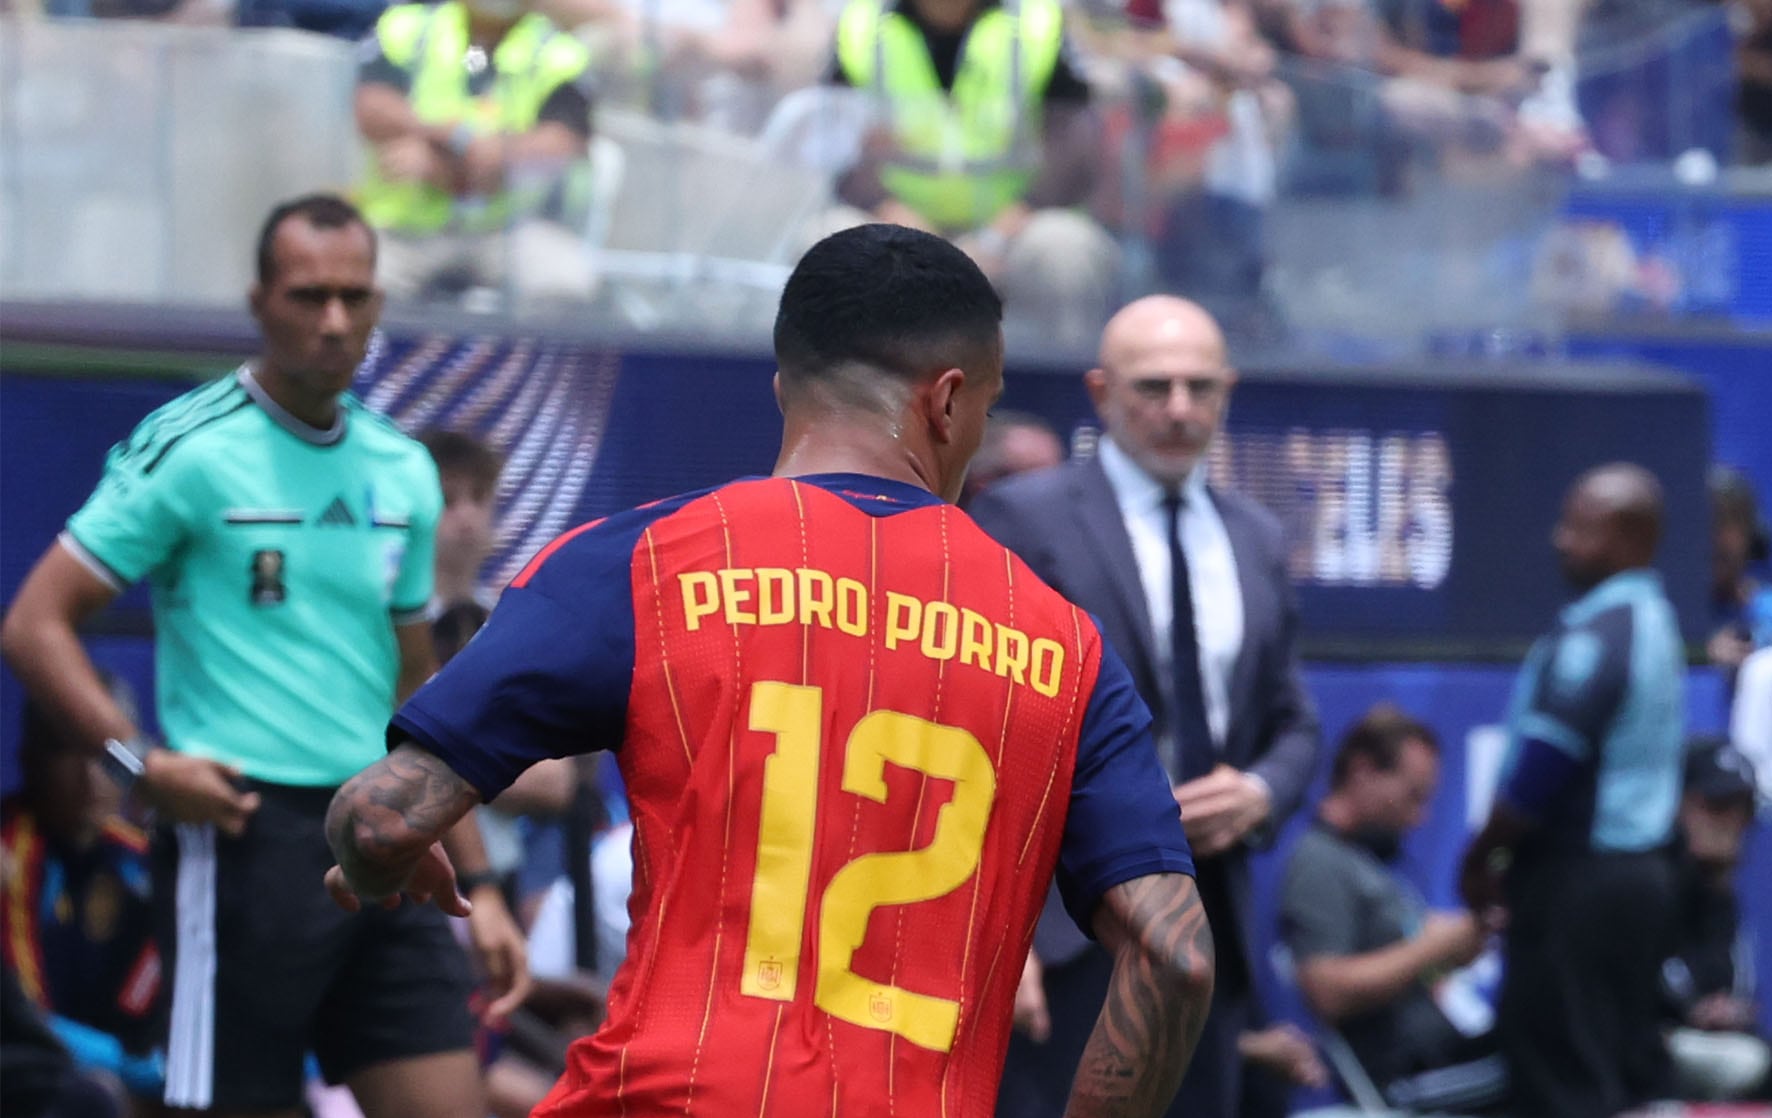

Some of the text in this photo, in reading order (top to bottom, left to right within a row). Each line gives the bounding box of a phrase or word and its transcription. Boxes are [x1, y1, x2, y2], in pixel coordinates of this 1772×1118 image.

[677, 567, 1065, 699] PEDRO PORRO
[740, 680, 996, 1053] 12
